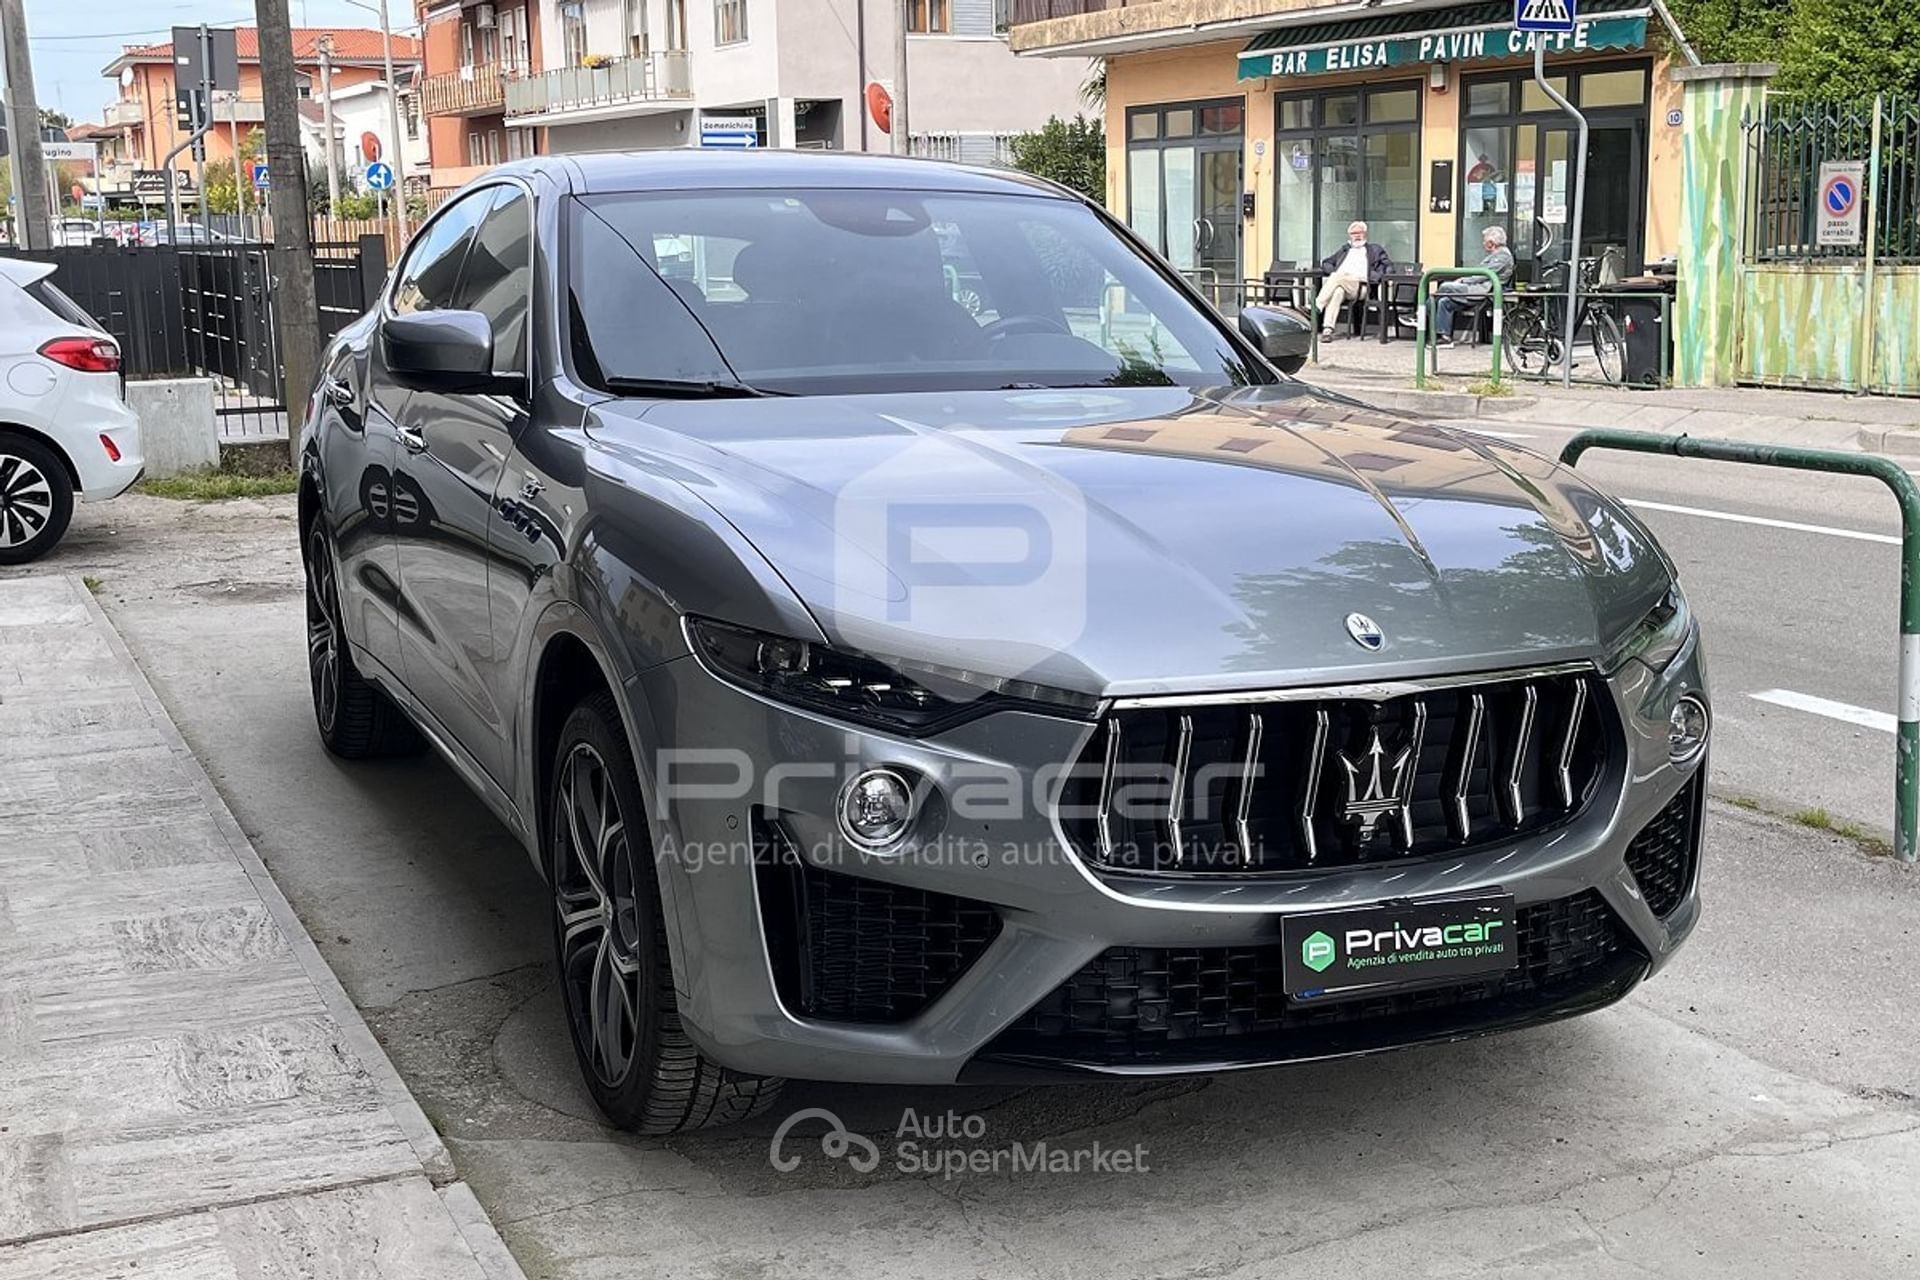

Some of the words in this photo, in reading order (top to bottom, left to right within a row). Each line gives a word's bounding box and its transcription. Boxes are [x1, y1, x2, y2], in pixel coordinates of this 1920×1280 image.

[1271, 51, 1307, 75] BAR
[1326, 42, 1387, 70] ELISA
[1419, 31, 1484, 60] PAVIN
[1670, 112, 1681, 123] 10
[1345, 921, 1503, 955] Privacar
[1347, 955, 1386, 970] Agenzia
[1387, 952, 1399, 964] di
[1399, 949, 1435, 963] vendita
[1436, 947, 1459, 959] auto
[1459, 945, 1474, 957] tra
[1475, 940, 1504, 958] privati
